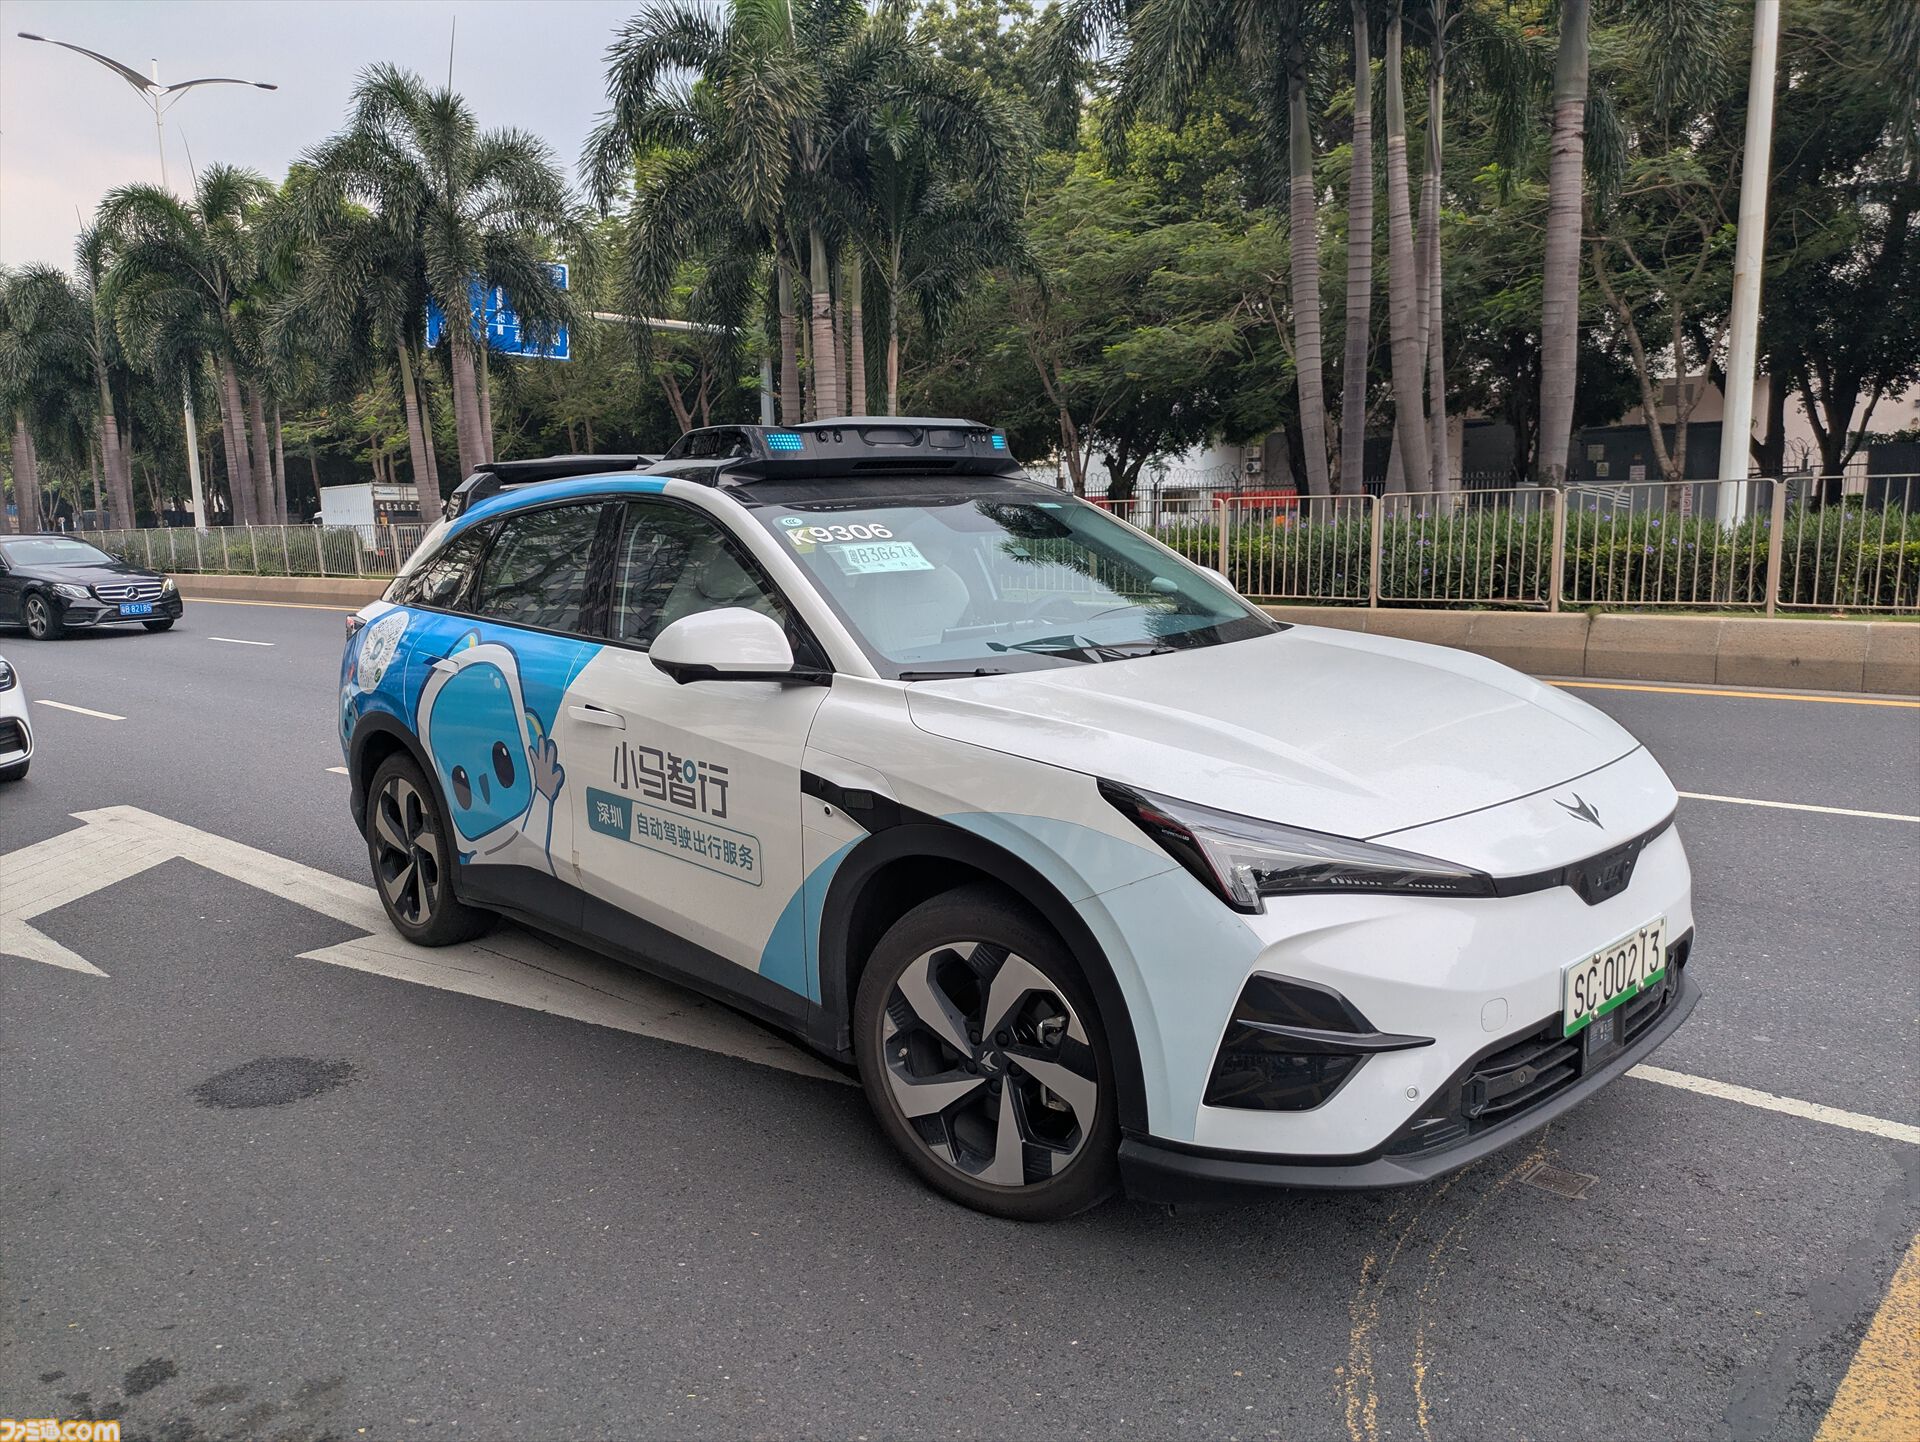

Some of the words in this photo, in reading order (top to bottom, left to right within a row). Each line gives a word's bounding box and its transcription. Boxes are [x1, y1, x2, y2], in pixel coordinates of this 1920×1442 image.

[785, 523, 894, 545] K9306
[613, 741, 729, 819] 小马智行
[596, 801, 624, 830] 深圳
[636, 812, 754, 871] 自动驾驶出行服务
